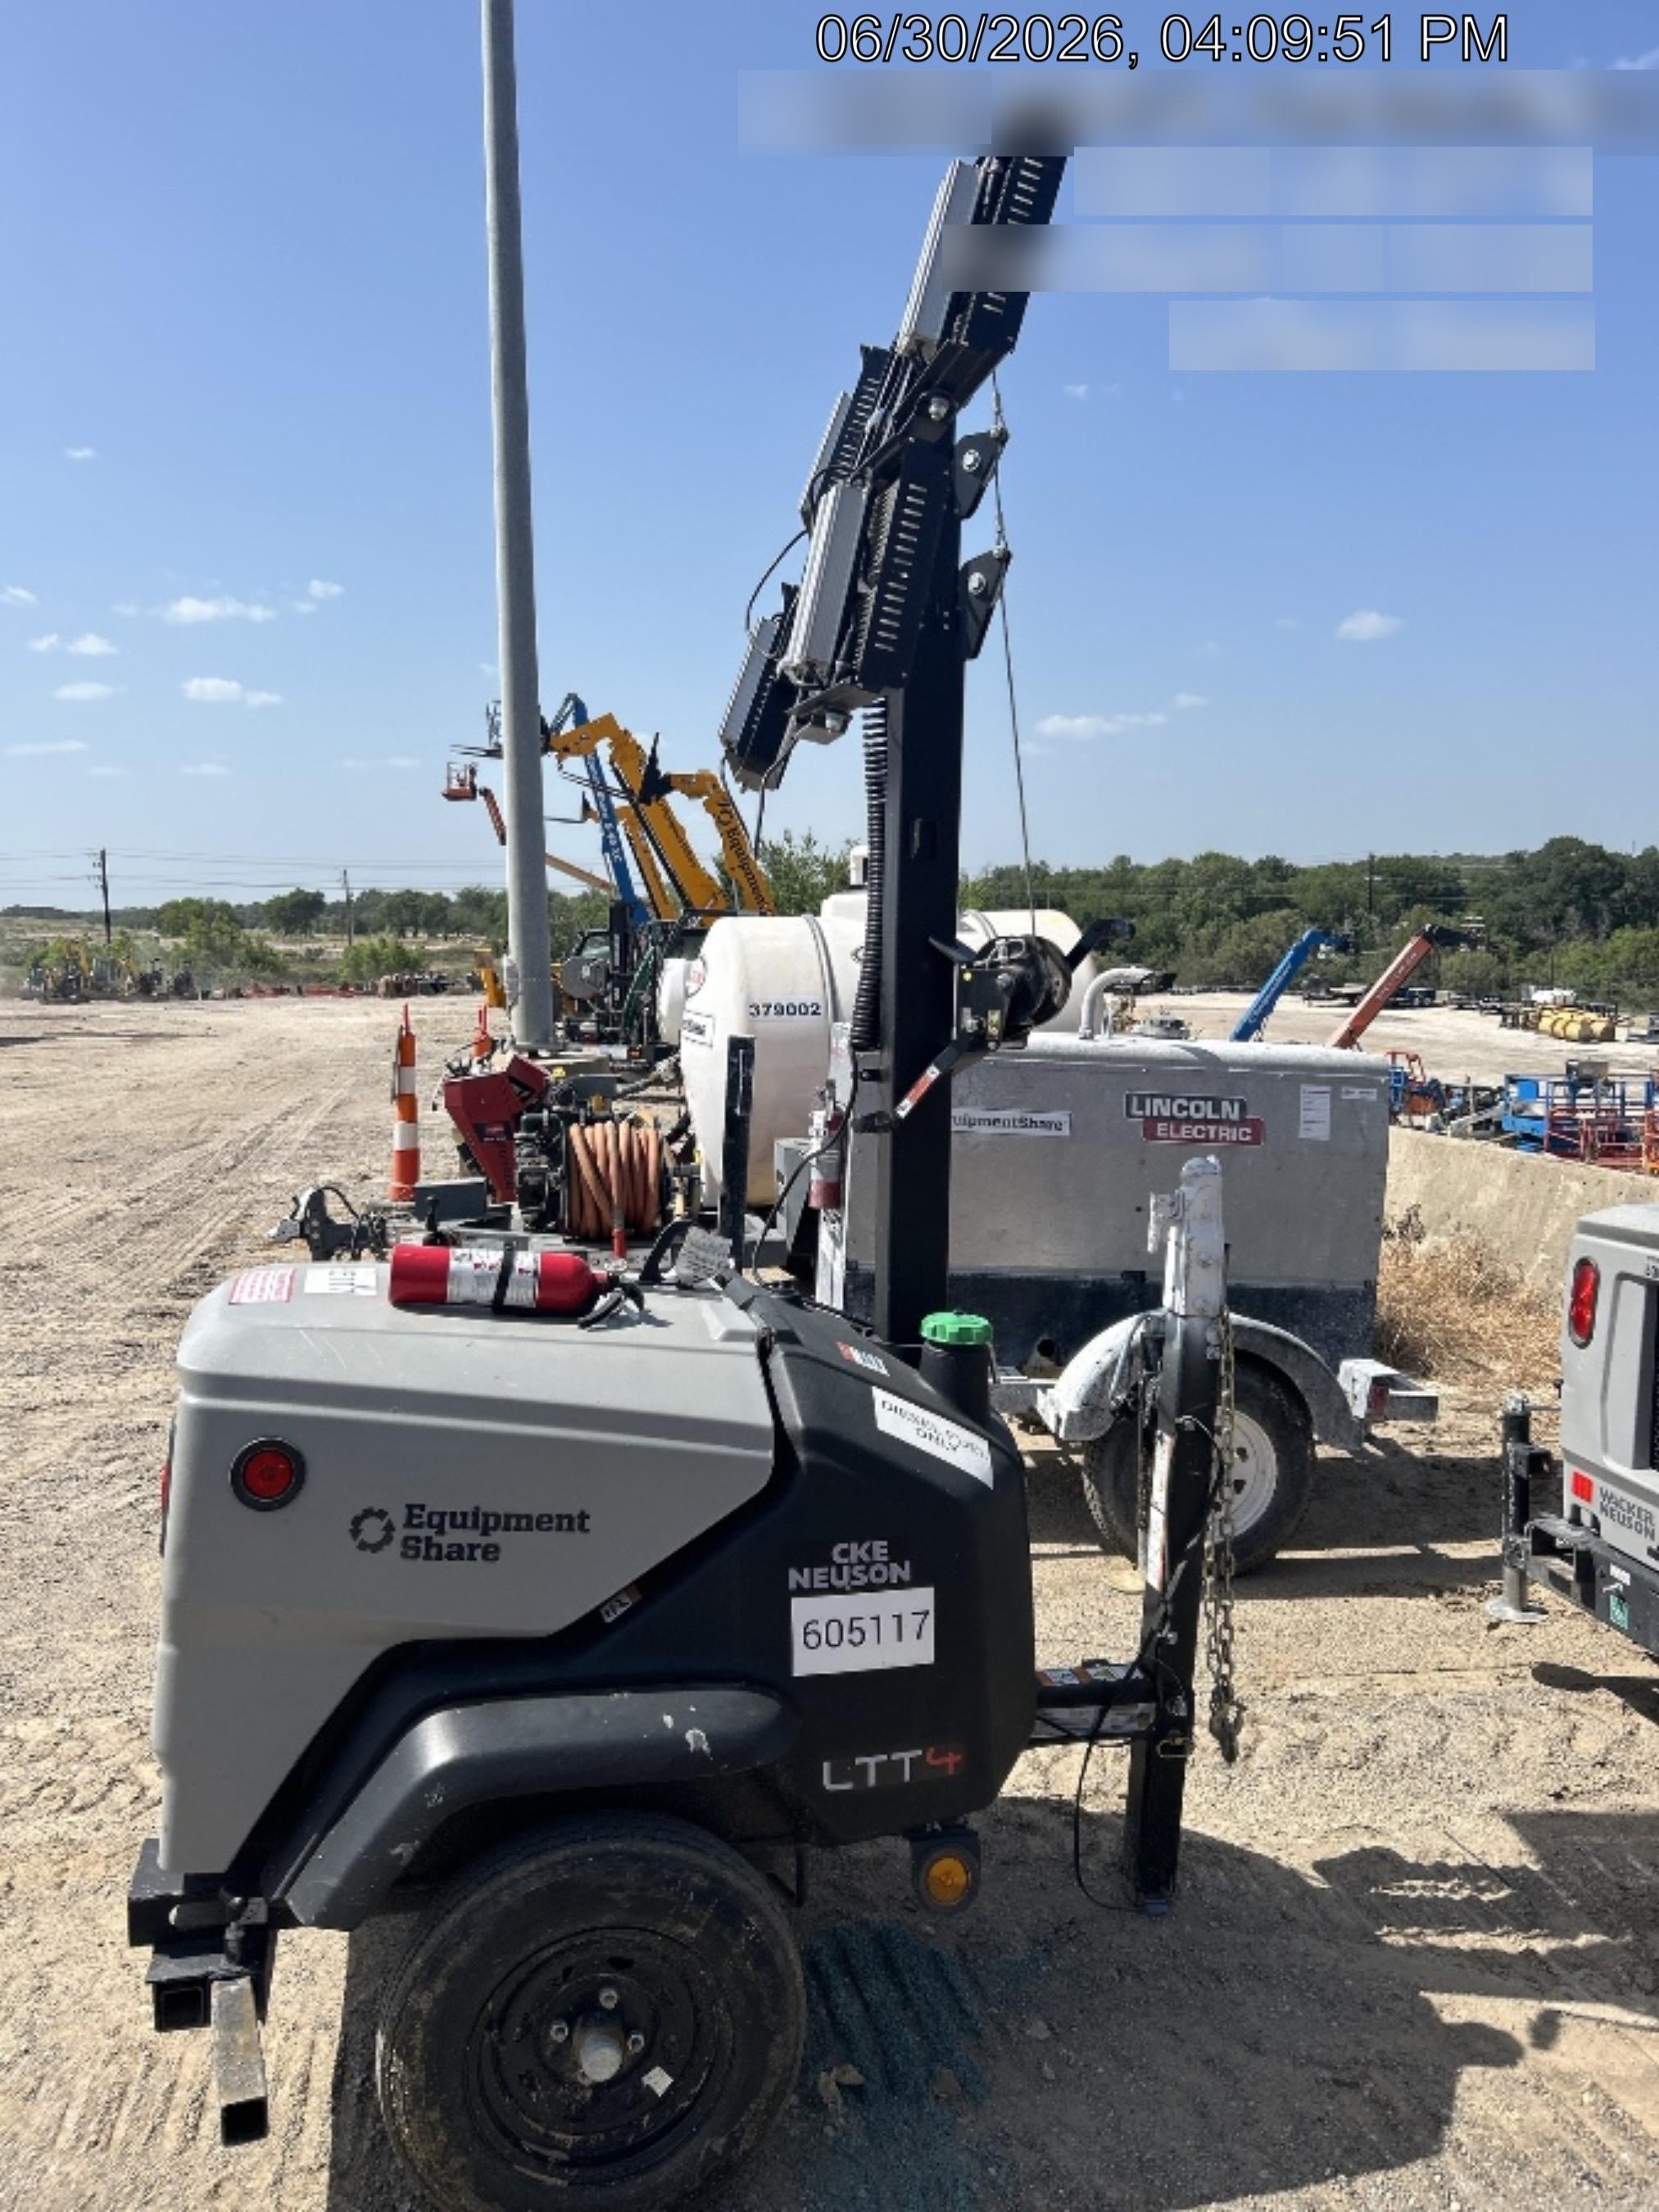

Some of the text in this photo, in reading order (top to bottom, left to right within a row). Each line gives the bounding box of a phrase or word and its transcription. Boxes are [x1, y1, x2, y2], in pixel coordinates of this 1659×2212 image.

[749, 1002, 822, 1017] 379002
[1131, 1095, 1240, 1122] LINCOLN
[1156, 1122, 1252, 1141] ELECTRIC
[403, 1503, 591, 1536] Equipment
[1599, 1486, 1655, 1526] WACKER
[1599, 1501, 1656, 1542] NEUSON
[400, 1535, 501, 1562] Share
[832, 1540, 889, 1564] CKE
[788, 1561, 911, 1589] NEUSON
[803, 1609, 930, 1650] 605117
[822, 1747, 963, 1791] LTT4
